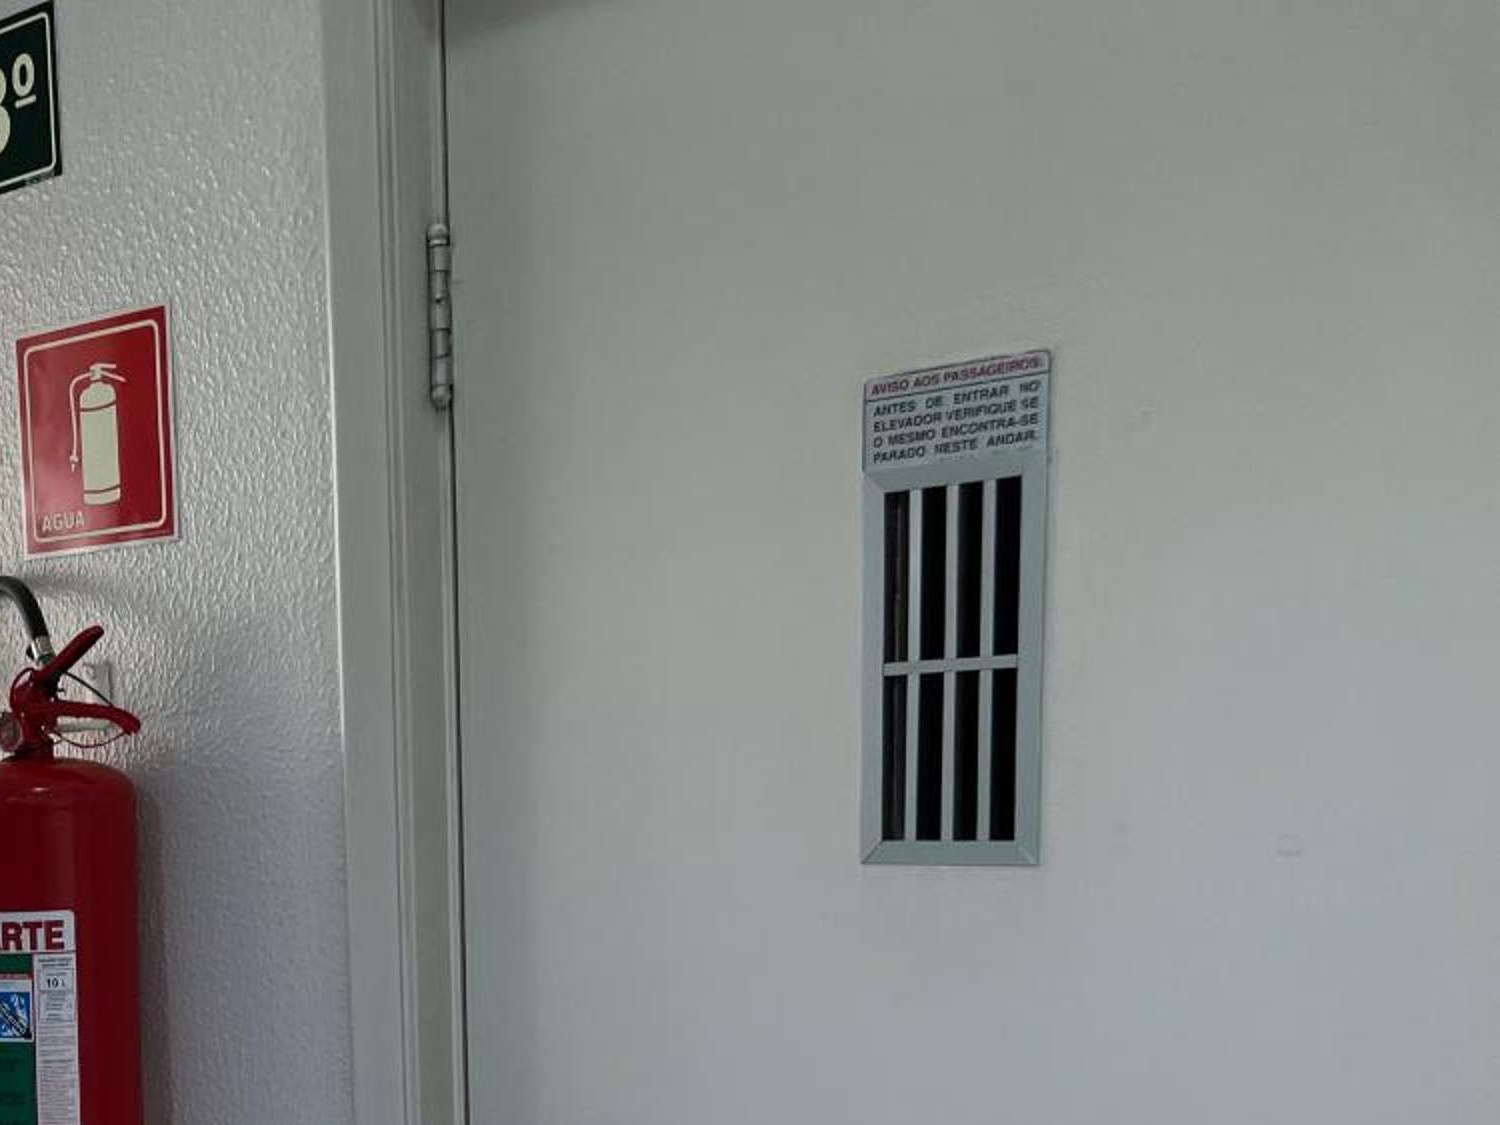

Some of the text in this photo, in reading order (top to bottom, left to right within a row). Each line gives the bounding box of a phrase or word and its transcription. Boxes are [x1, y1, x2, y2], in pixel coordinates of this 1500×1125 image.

[870, 357, 1040, 396] AVISO AOS PASSAGEIROS
[873, 379, 1041, 417] ANTES DE ENTRAR NO
[873, 395, 1039, 433] ELEVADOR VERIFIQUE SE
[873, 411, 1039, 449] O MESMO ENCONTRA-SE
[873, 445, 926, 465] PARADO
[934, 438, 979, 456] NESTE
[46, 977, 59, 988] 10
